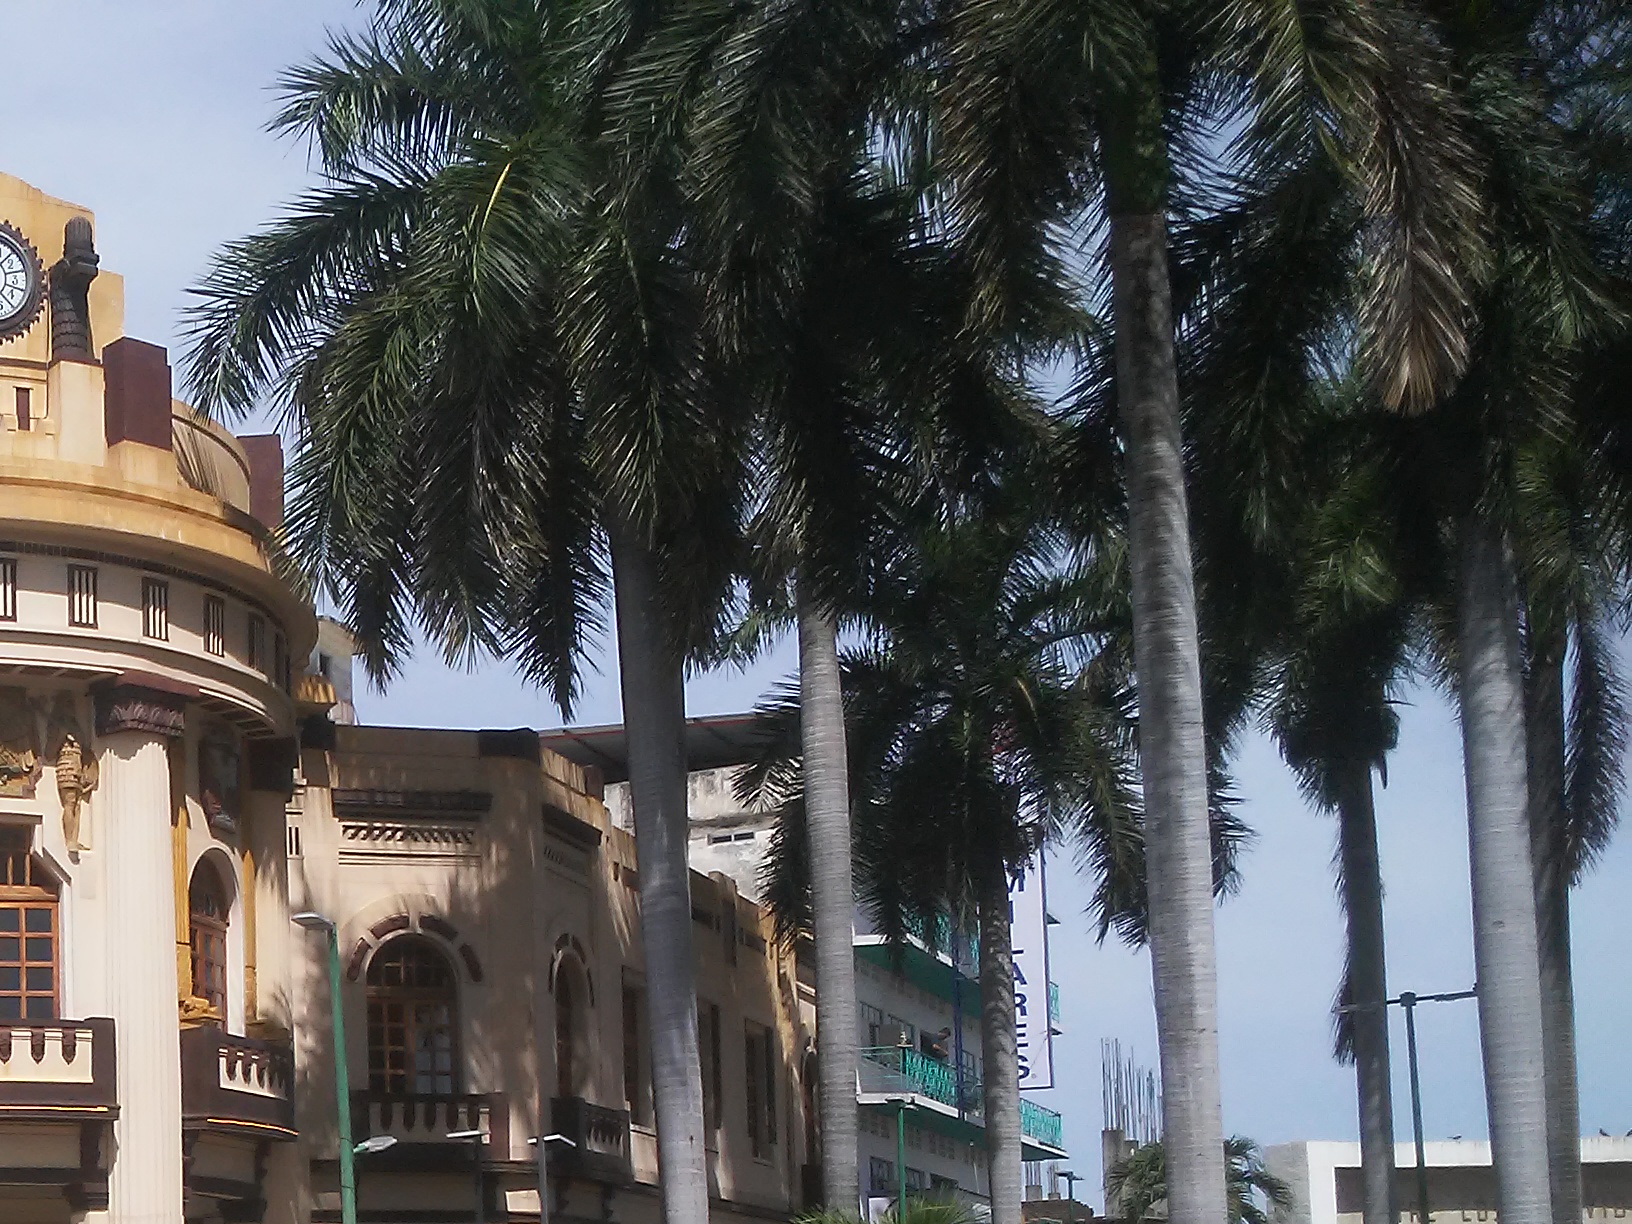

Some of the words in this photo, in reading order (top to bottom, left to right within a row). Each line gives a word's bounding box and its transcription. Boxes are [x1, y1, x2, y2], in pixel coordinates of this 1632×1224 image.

[7, 259, 14, 270] 2
[12, 275, 19, 285] 3
[7, 289, 15, 300] 4
